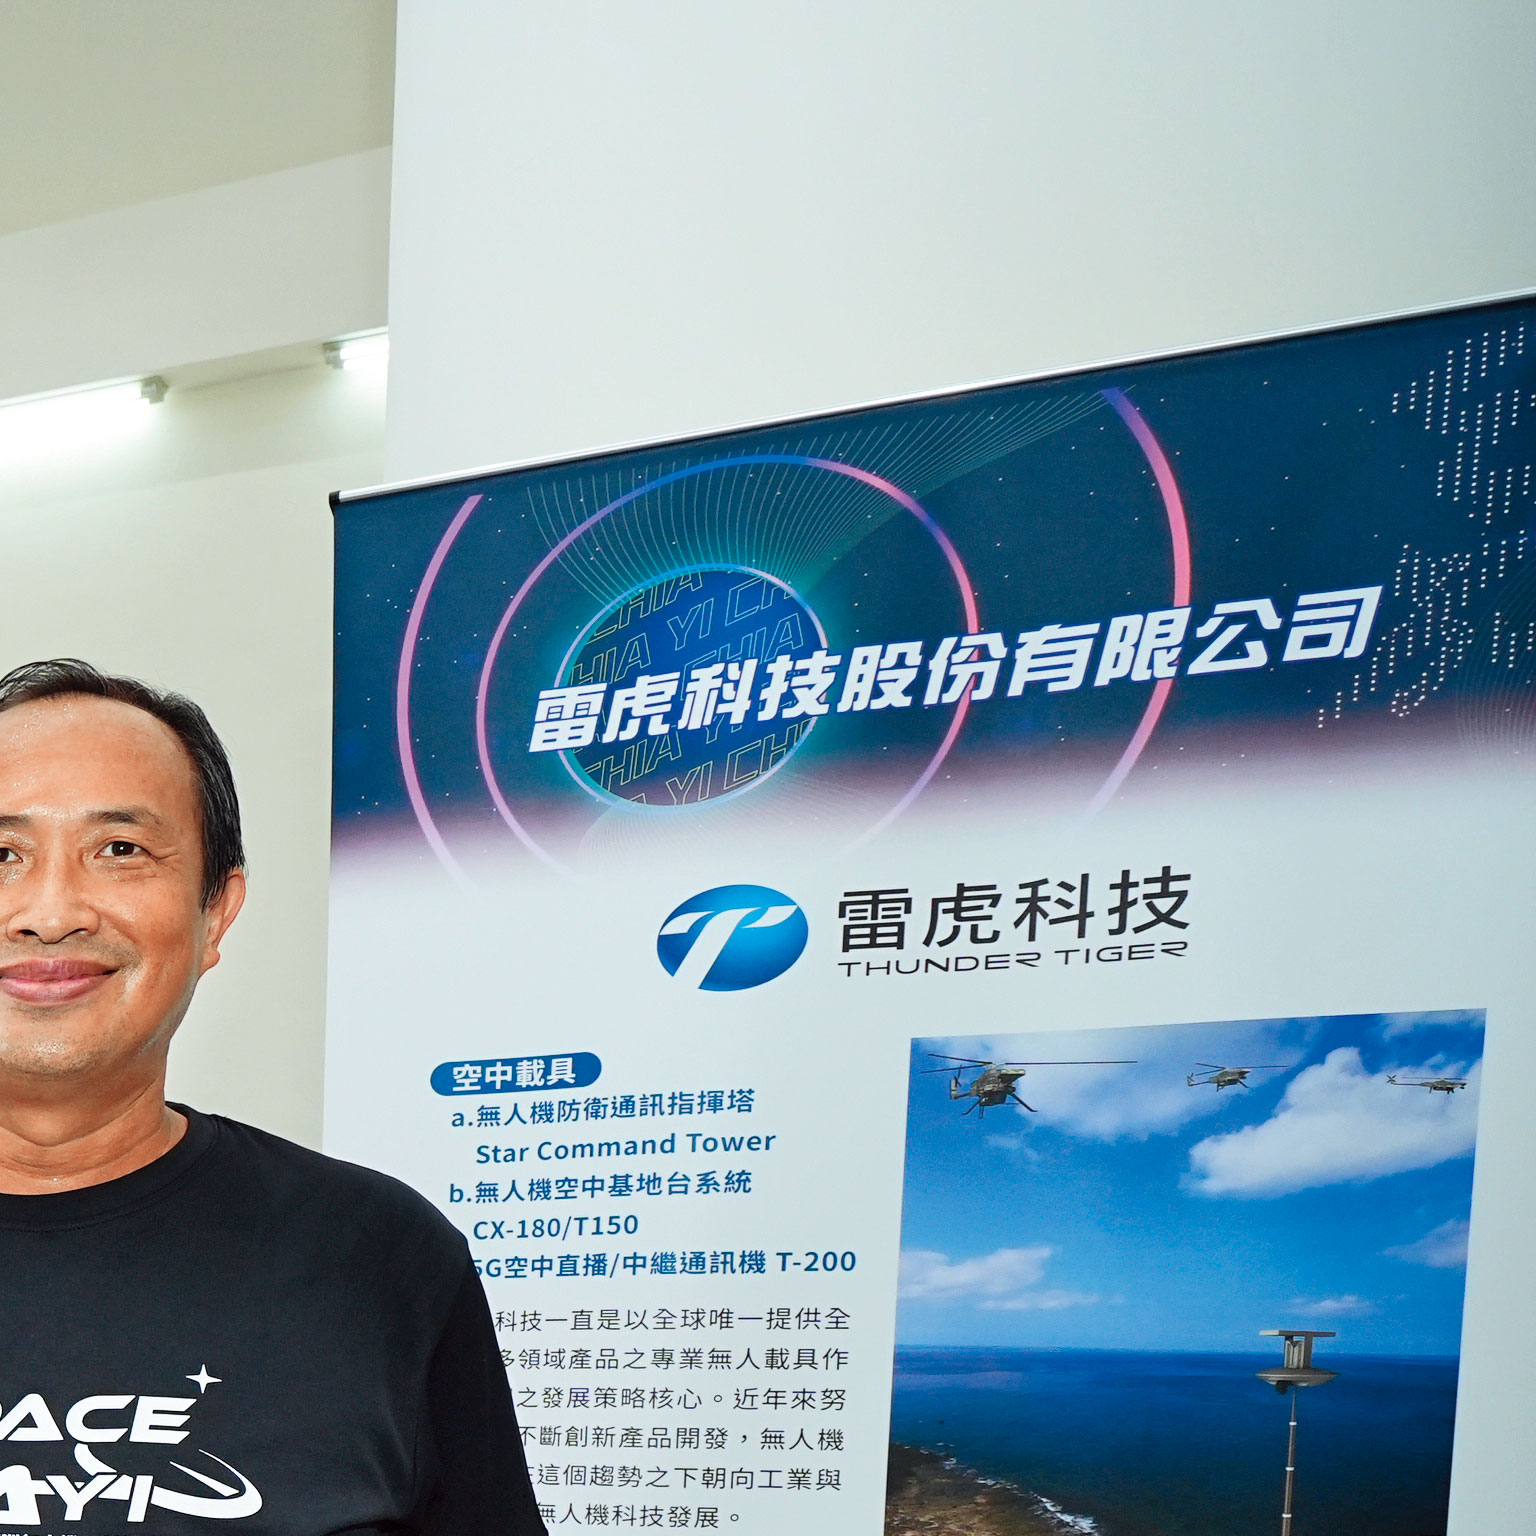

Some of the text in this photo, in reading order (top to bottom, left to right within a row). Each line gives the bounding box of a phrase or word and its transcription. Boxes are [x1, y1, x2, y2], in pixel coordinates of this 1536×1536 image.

[528, 586, 1384, 752] 雷虎科技股份有限公司
[836, 865, 1192, 954] 雷虎科技
[836, 940, 1190, 977] THUNDER TIGER
[451, 1056, 577, 1093] 空中載具
[451, 1088, 756, 1128] a.無人機防衛通訊指揮塔
[476, 1131, 778, 1165] Star Command Tower
[449, 1168, 753, 1205] b.無人機空中基地台系統
[473, 1213, 640, 1242] CX-180/T150
[776, 1251, 857, 1273] T-200
[495, 1307, 851, 1332] 科技一直是以全球唯一提供全
[500, 1347, 850, 1371] 多領域產品之專業無人載具作
[516, 1386, 846, 1412] 之發展策略核心。近年來努
[518, 1425, 845, 1452] 不斷創新產品開發，無人機
[537, 1502, 741, 1529] 無人機科技發展。
